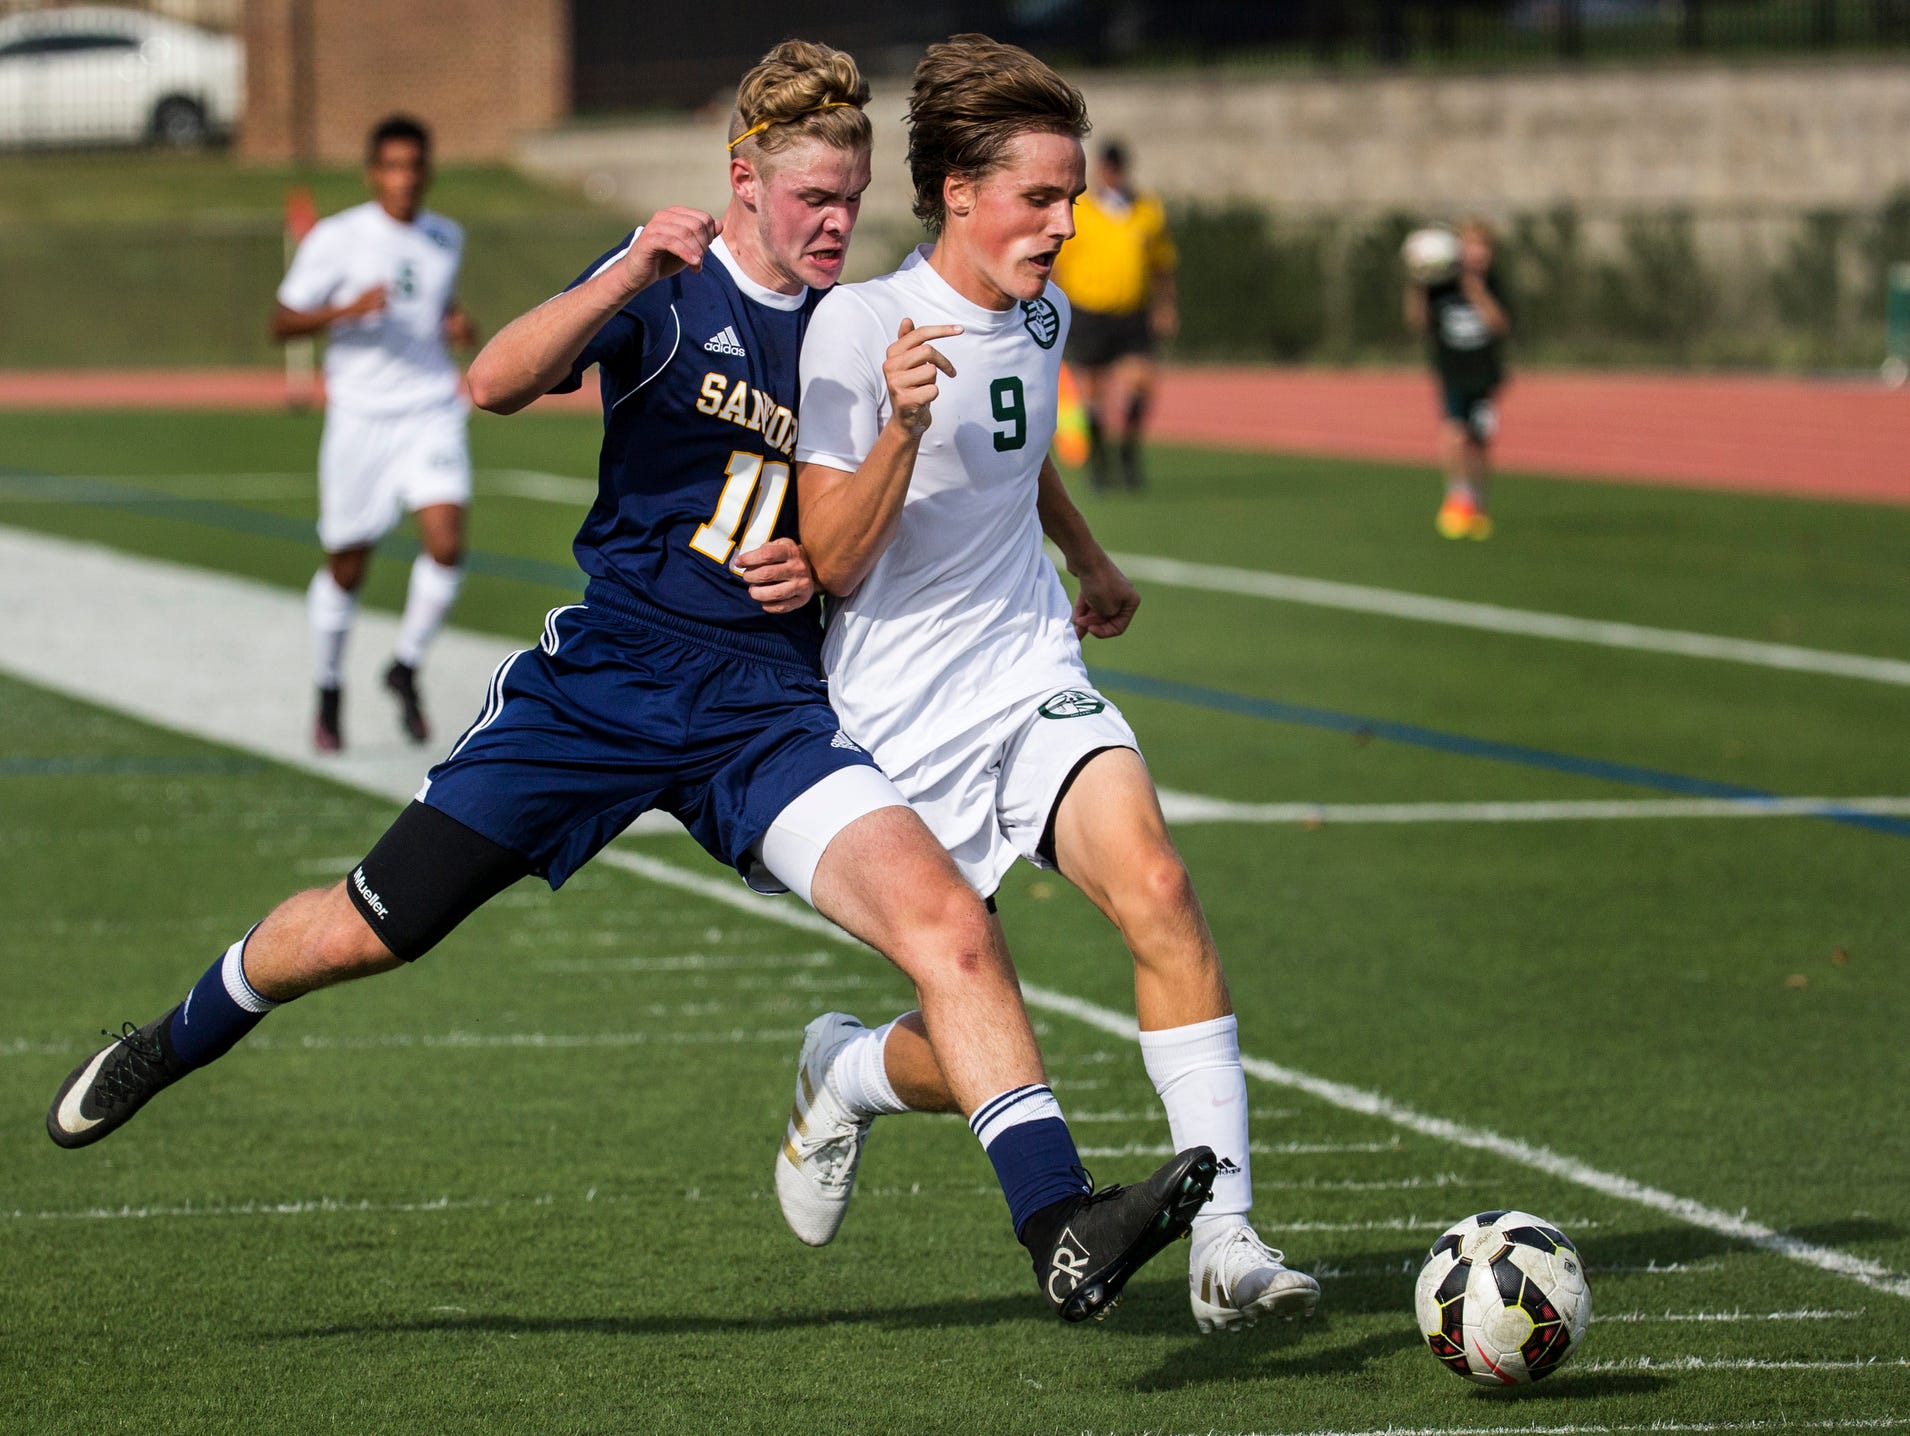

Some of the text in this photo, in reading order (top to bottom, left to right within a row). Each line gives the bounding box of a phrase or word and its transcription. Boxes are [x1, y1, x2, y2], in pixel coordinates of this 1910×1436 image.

[704, 339, 746, 357] adidas
[990, 376, 1026, 453] 9
[1048, 1227, 1091, 1304] CR7
